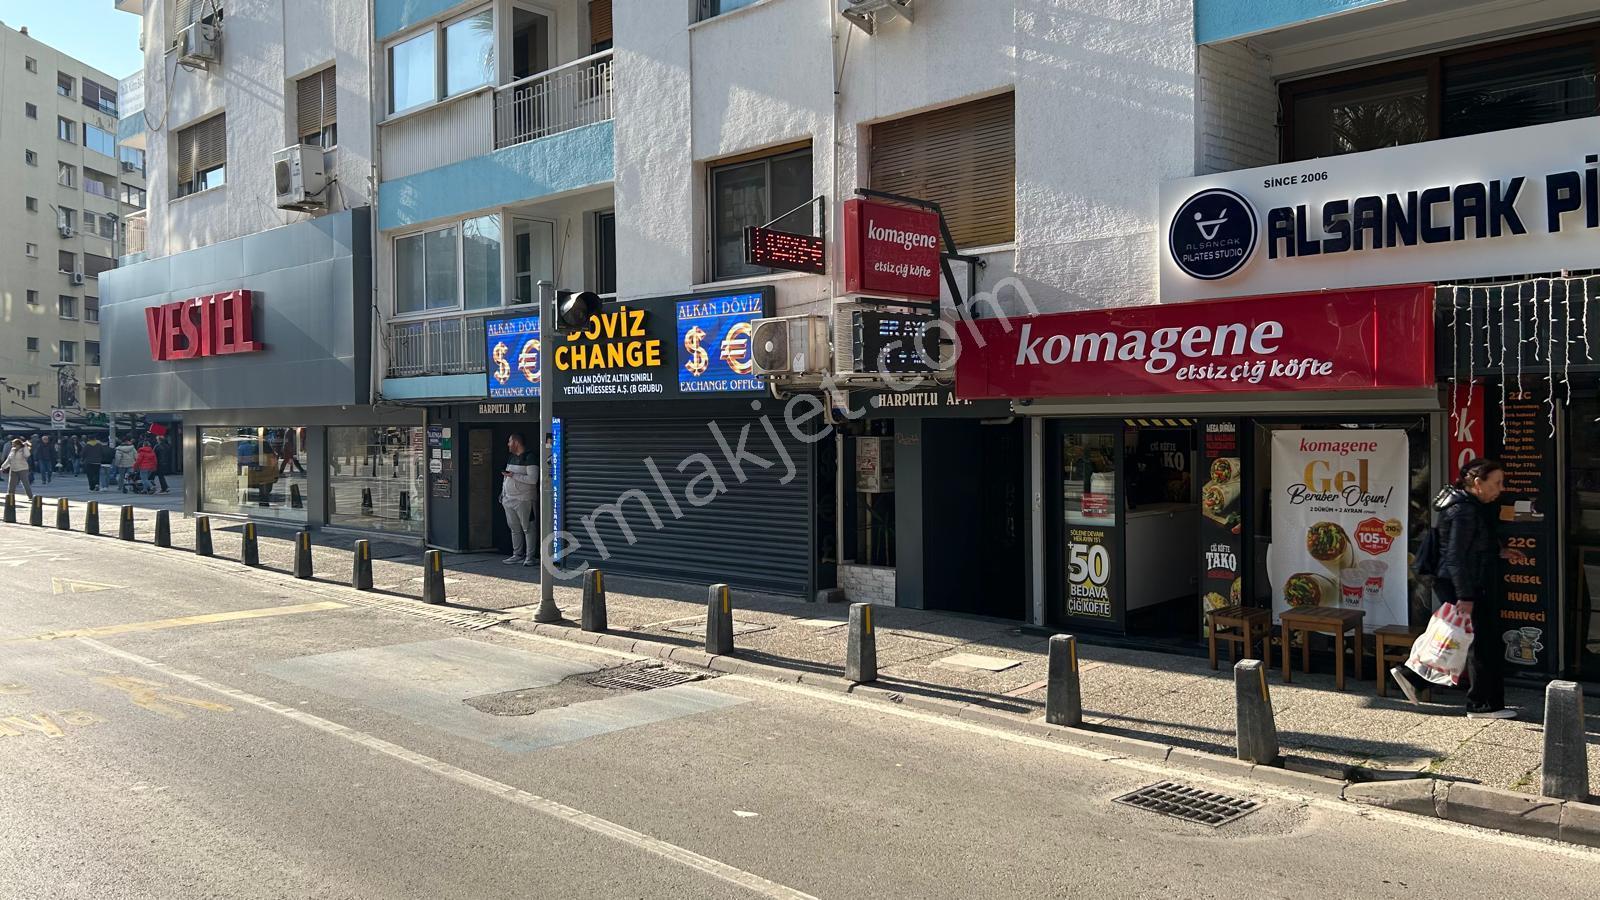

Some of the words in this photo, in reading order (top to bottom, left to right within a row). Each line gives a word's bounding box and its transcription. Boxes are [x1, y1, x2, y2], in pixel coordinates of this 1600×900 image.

[1301, 171, 1328, 185] 2006
[1267, 176, 1527, 260] ALSANCAK
[868, 219, 937, 250] komagene
[1186, 238, 1240, 250] ALSANCAK
[1215, 248, 1243, 259] STUDIO
[874, 262, 895, 274] etsiz
[895, 263, 908, 278] çiğ
[909, 264, 931, 277] köfte
[678, 303, 717, 318] ALKAN
[722, 296, 761, 314] DÖVİZ
[144, 289, 260, 361] VESTEL
[488, 322, 515, 335] ALKAN
[555, 339, 661, 371] CHANGE
[1015, 320, 1283, 375] komagene
[571, 375, 591, 384] ALKAN
[592, 373, 611, 384] DÖVİZ
[612, 374, 630, 383] ALTIN
[630, 372, 653, 382] SINIRLI
[1175, 361, 1227, 381] etsiz
[1230, 359, 1267, 384] çiğ
[1269, 357, 1333, 378] köfte
[490, 387, 525, 397] EXCHANGE
[563, 384, 585, 395] YETKİLİ
[586, 383, 616, 395] MÜESSESE
[617, 385, 628, 394] A.Ş.
[629, 384, 637, 394] (B
[638, 384, 663, 394] GRUBU)
[680, 380, 728, 392] EXCHANGE
[730, 380, 764, 390] OFFICE
[878, 392, 938, 407] HARPUTLU
[479, 404, 510, 414] HARPUTLU
[514, 403, 527, 413] APT.
[1299, 437, 1378, 456] komagene
[1304, 458, 1369, 494] Gel
[1287, 483, 1339, 505] Beraber
[1342, 485, 1393, 508] Olsun!
[1507, 537, 1537, 548] 22C
[1205, 552, 1237, 572] TAKO
[1071, 584, 1108, 598] BEDAVA
[1507, 591, 1538, 603] KURU
[1068, 597, 1082, 613] ÇİĞ
[1083, 598, 1110, 614] KÖFTE
[1500, 608, 1546, 622] KAHVECİ
